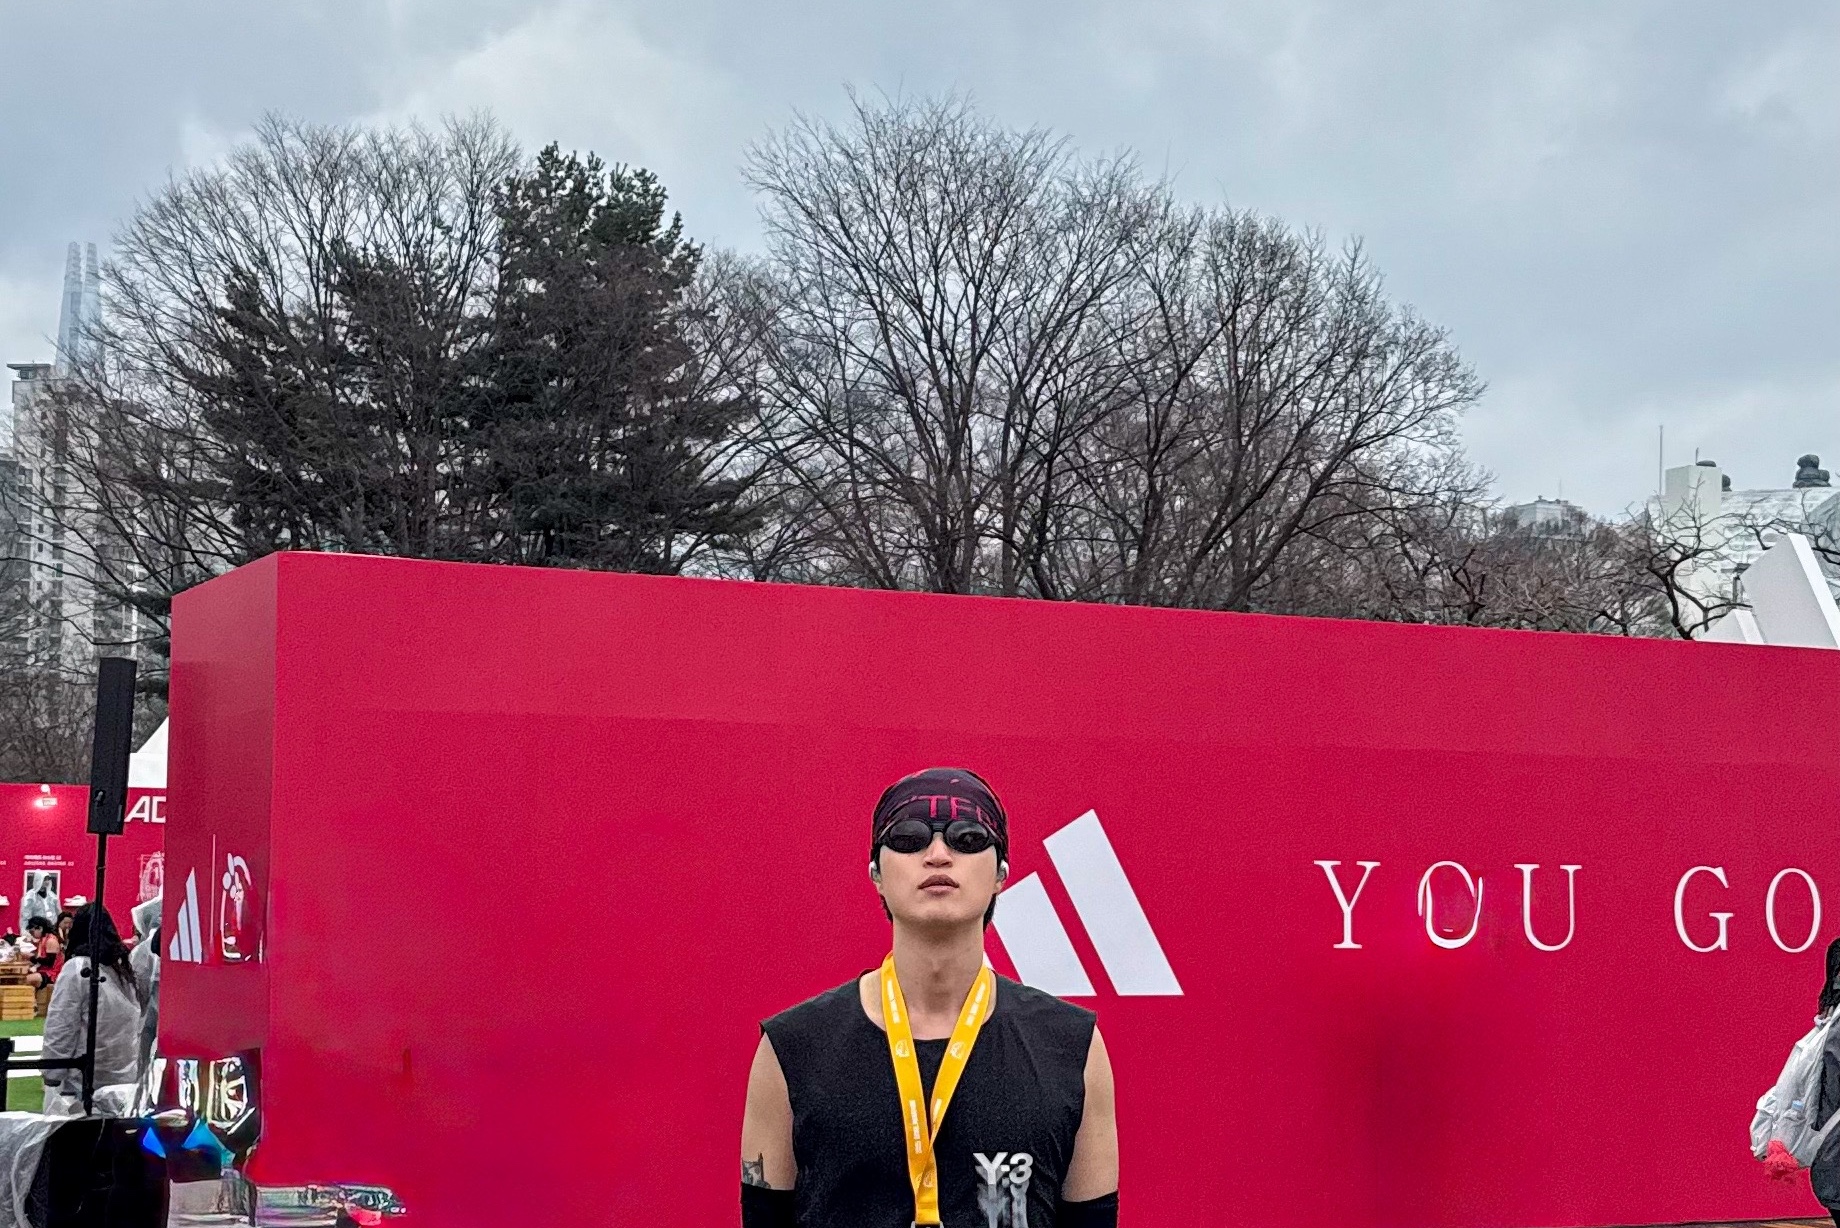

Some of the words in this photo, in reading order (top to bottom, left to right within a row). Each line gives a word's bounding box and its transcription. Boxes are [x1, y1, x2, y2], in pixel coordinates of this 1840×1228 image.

[1313, 860, 1582, 951] YOU
[1674, 866, 1822, 953] GO
[973, 1152, 1034, 1185] Y-3
